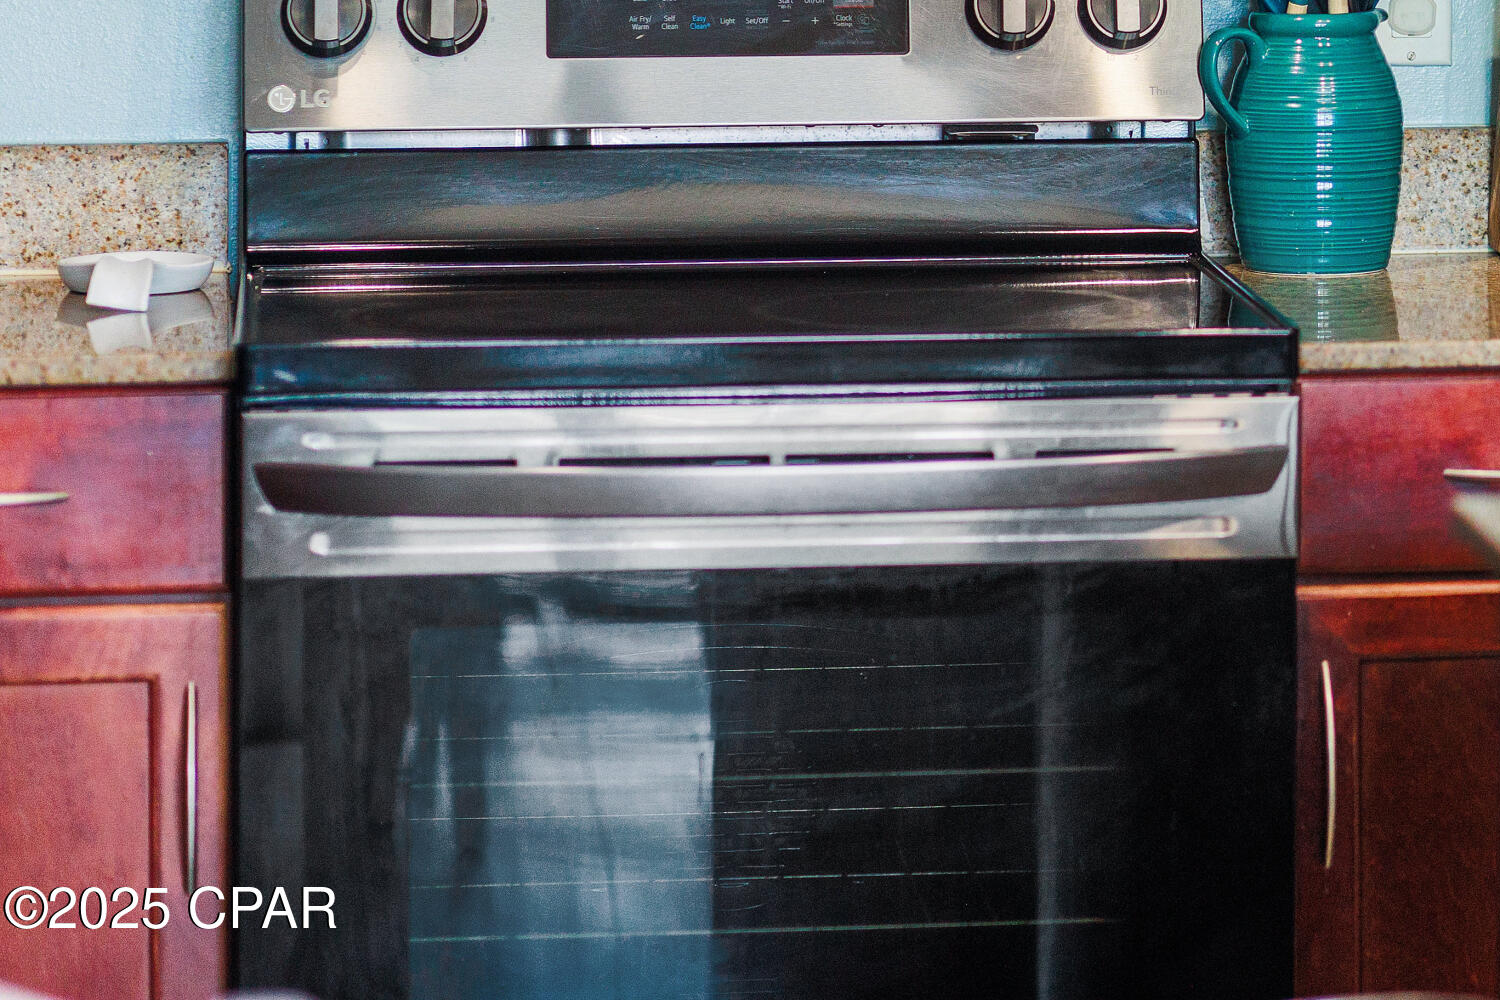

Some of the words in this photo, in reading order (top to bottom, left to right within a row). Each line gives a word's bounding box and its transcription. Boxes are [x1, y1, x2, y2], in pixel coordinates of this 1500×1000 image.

[628, 15, 638, 23] Air
[663, 14, 676, 22] Self
[692, 14, 706, 23] Easy
[720, 17, 736, 26] Light
[745, 16, 769, 25] Set/Off
[300, 89, 330, 108] LG
